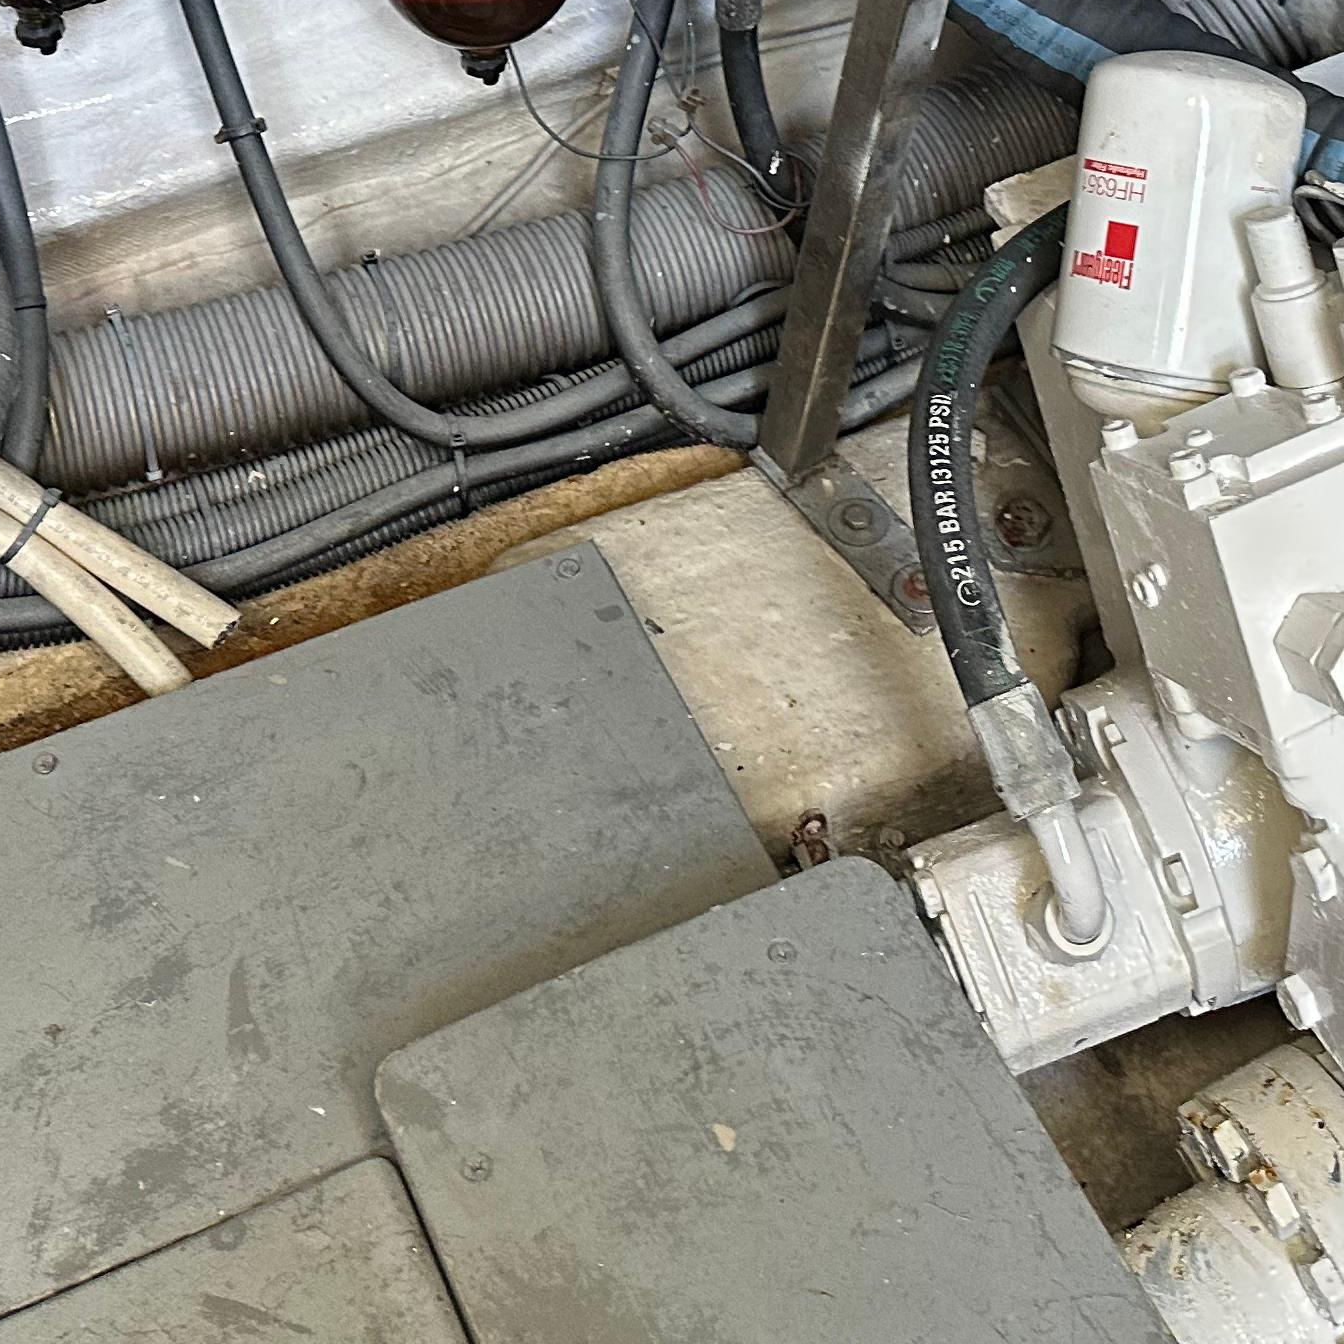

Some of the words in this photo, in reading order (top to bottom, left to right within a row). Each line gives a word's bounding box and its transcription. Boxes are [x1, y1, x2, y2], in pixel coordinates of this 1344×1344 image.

[928, 393, 953, 429] PSI)
[928, 433, 954, 486] (3125
[933, 489, 961, 534] BAR
[942, 538, 973, 582] 215
